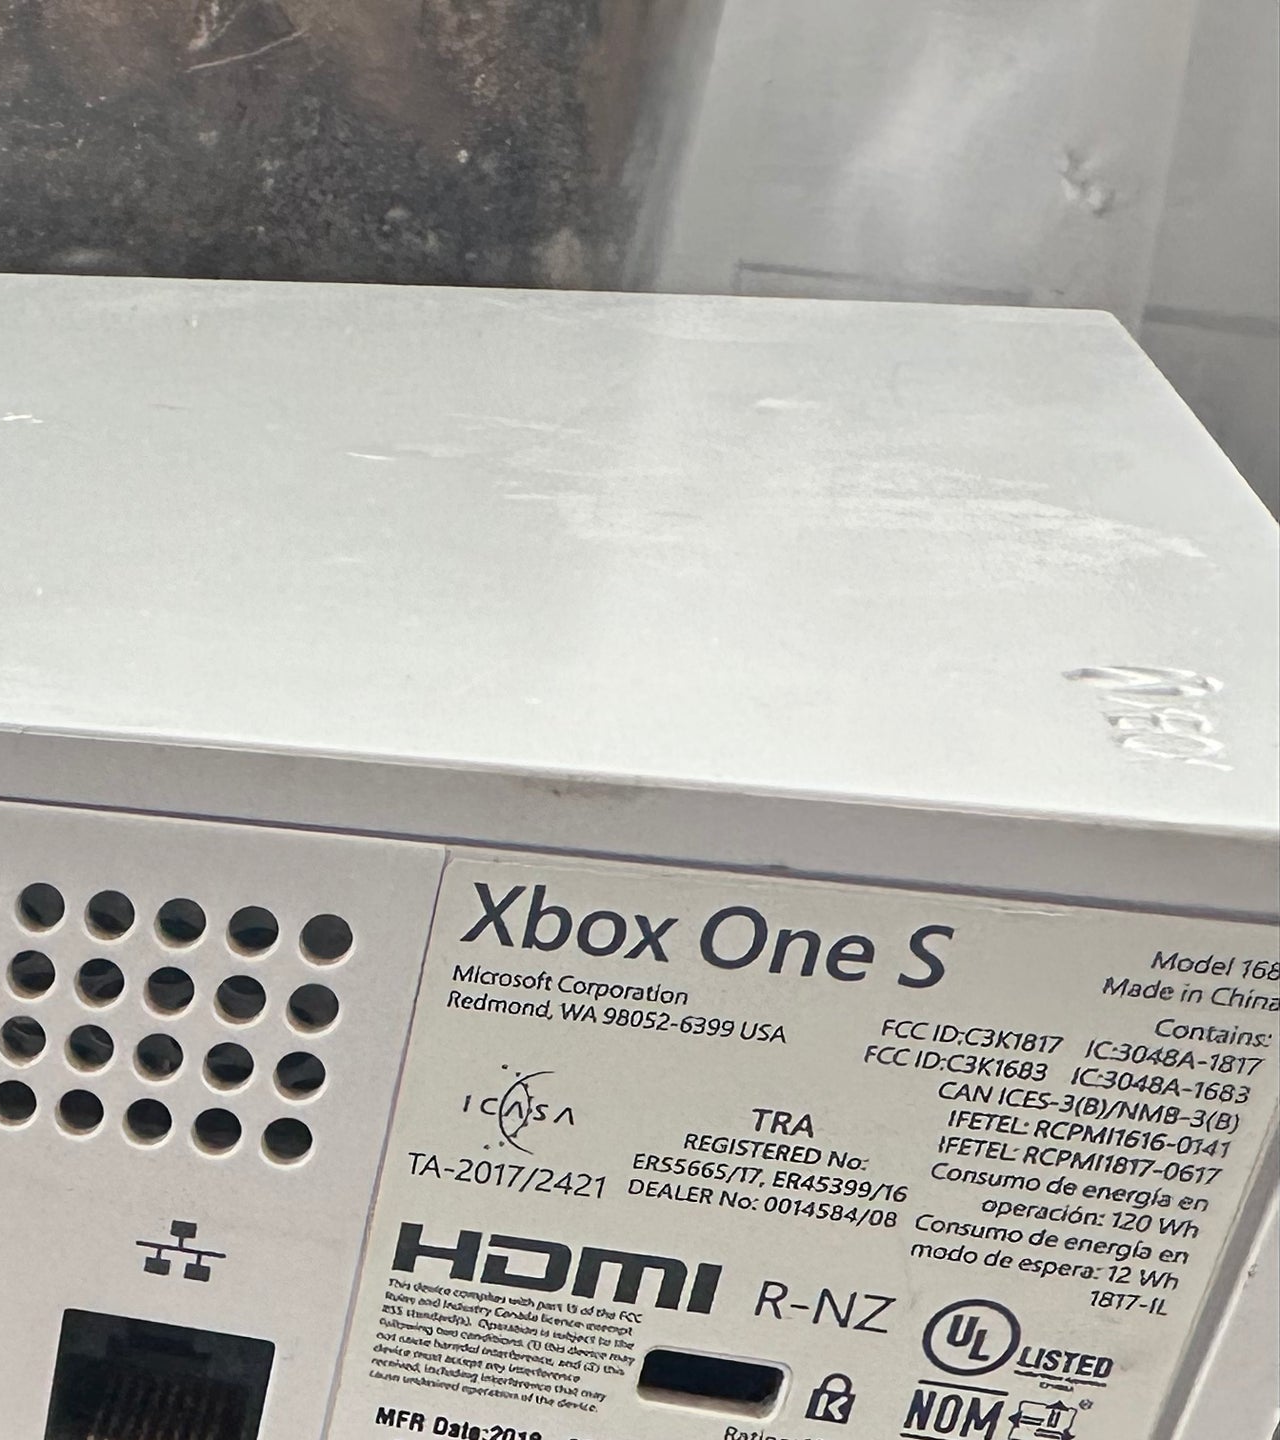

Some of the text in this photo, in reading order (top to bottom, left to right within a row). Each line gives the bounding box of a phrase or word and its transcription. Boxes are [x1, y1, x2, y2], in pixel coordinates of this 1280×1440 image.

[460, 882, 954, 989] Xbox One S
[1151, 951, 1236, 976] Model
[452, 965, 688, 1005] Microsoft Corporation
[1102, 977, 1280, 1012] Made in China
[446, 990, 786, 1043] Redmond, WA 98052-6399 USA
[881, 1019, 928, 1041] FCC
[1154, 1018, 1272, 1048] Contains:
[864, 1045, 912, 1066] FCC
[751, 1107, 815, 1138] TRA
[938, 1081, 1240, 1134] CAN ICES-3(B)/NMB-3(B)
[948, 1109, 1029, 1136] IFETEL:
[683, 1133, 869, 1172] REGISTERED No:
[408, 1151, 607, 1199] TA-2017/2421
[771, 1169, 909, 1203] ER45399/16
[930, 1162, 1209, 1213] Consumo de energía en
[627, 1178, 898, 1228] DEALER No: 0014584/08
[914, 1213, 1189, 1265] Consumo de energía en
[1111, 1211, 1153, 1233] 120
[1159, 1217, 1200, 1239] Wh
[391, 1221, 722, 1315] HDMI
[910, 1242, 1180, 1291] modo de espera: 12 Wh
[754, 1280, 897, 1334] R-NZ
[1016, 1346, 1114, 1378] LISTED
[375, 1406, 425, 1432] MFR
